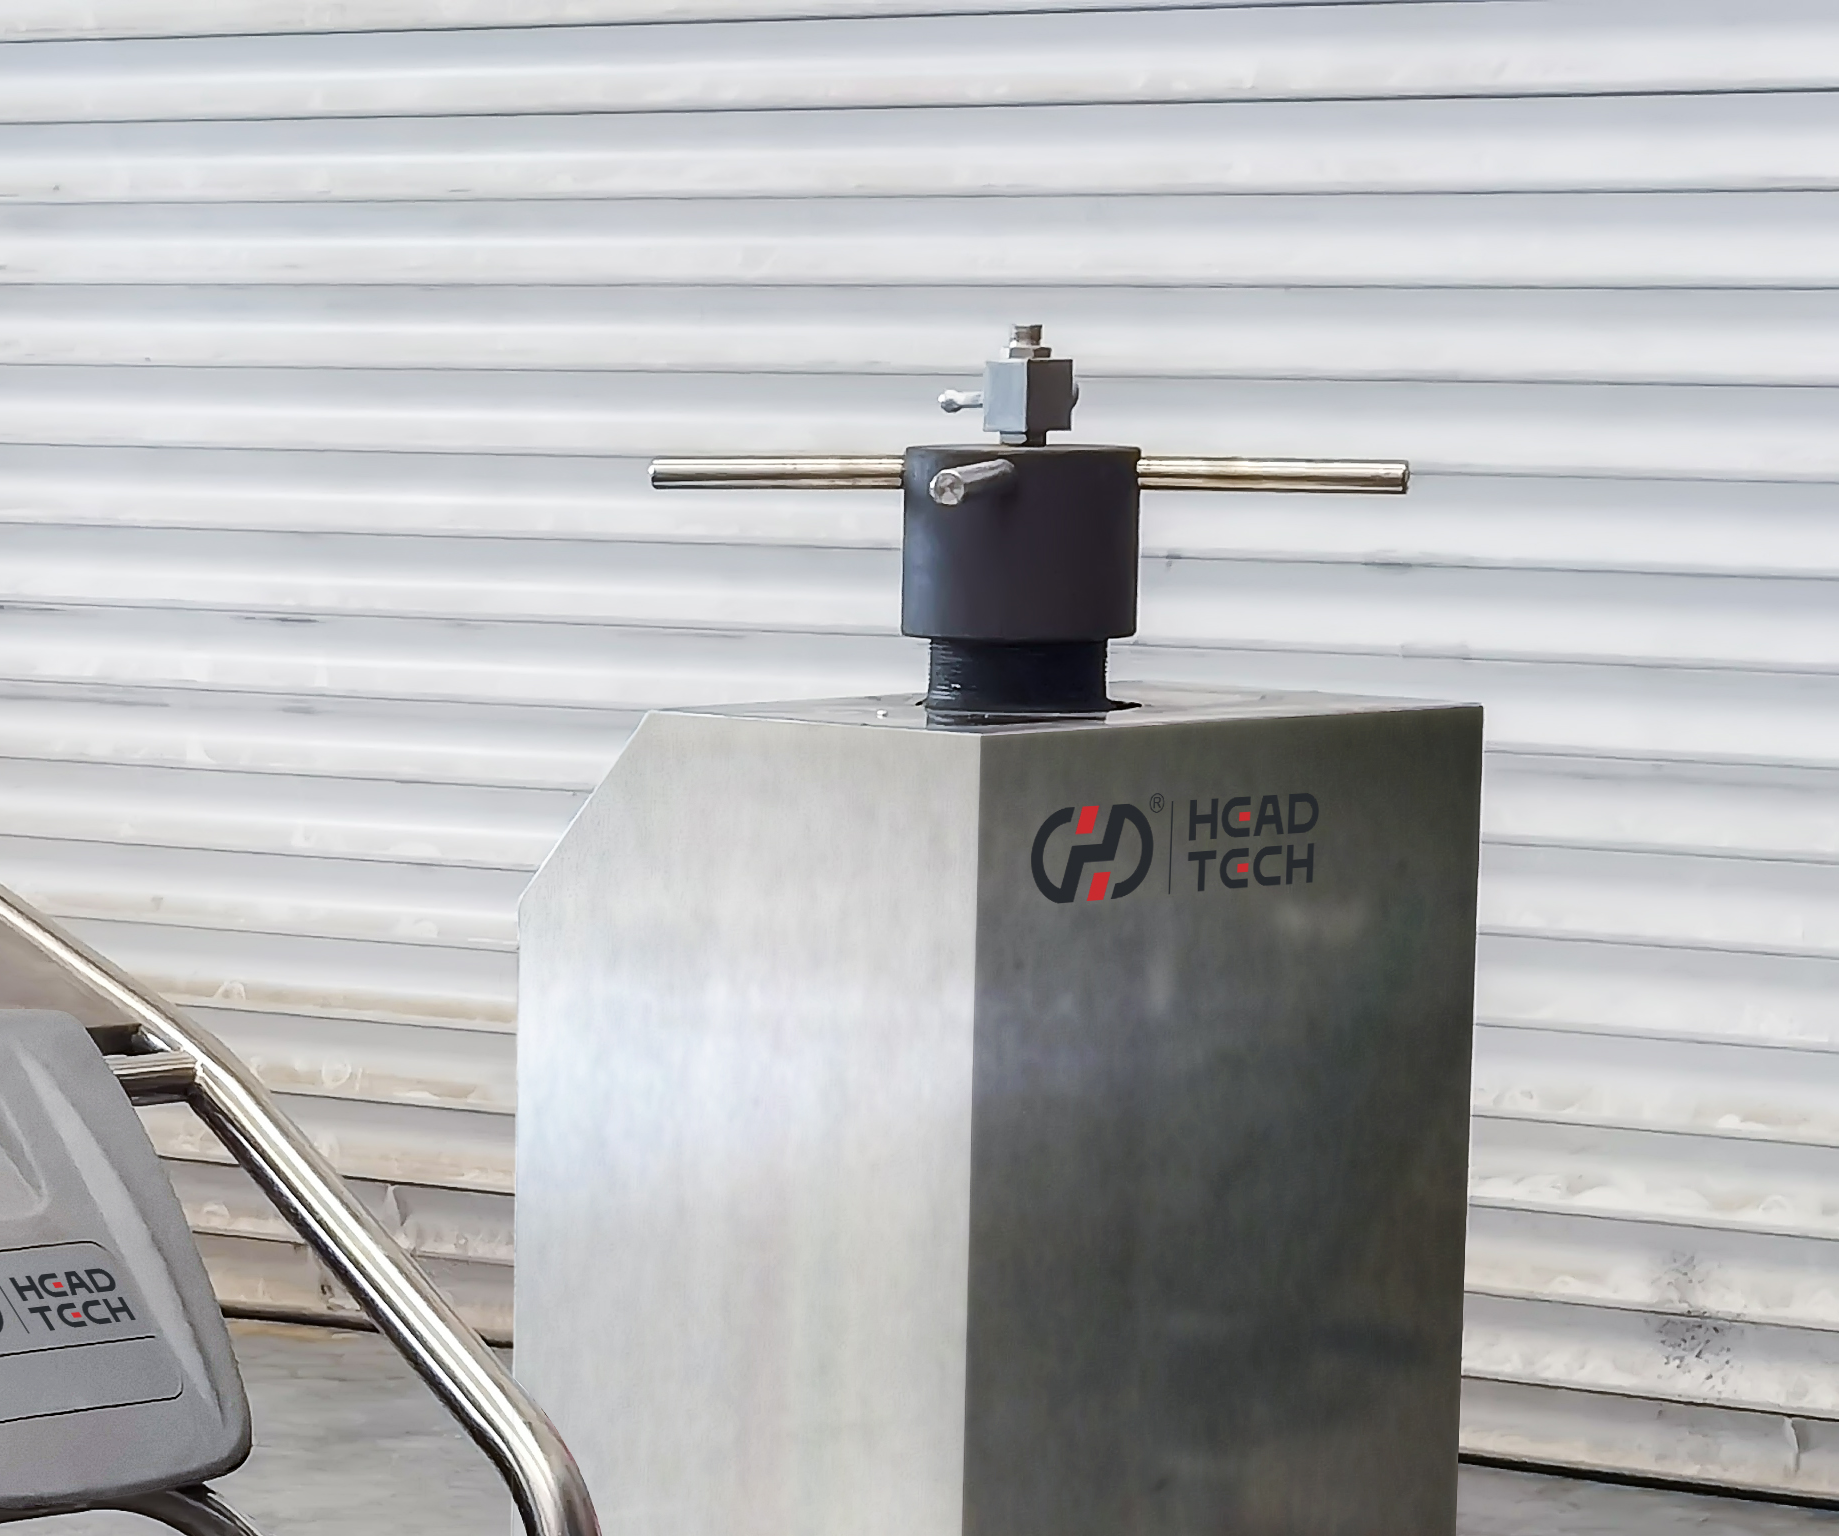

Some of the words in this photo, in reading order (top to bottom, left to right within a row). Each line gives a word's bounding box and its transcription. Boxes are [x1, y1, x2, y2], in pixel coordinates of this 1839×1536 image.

[1188, 792, 1320, 841] HEAD
[1188, 842, 1316, 892] TECH
[8, 1267, 117, 1302] HEAD
[27, 1296, 137, 1332] TECH
